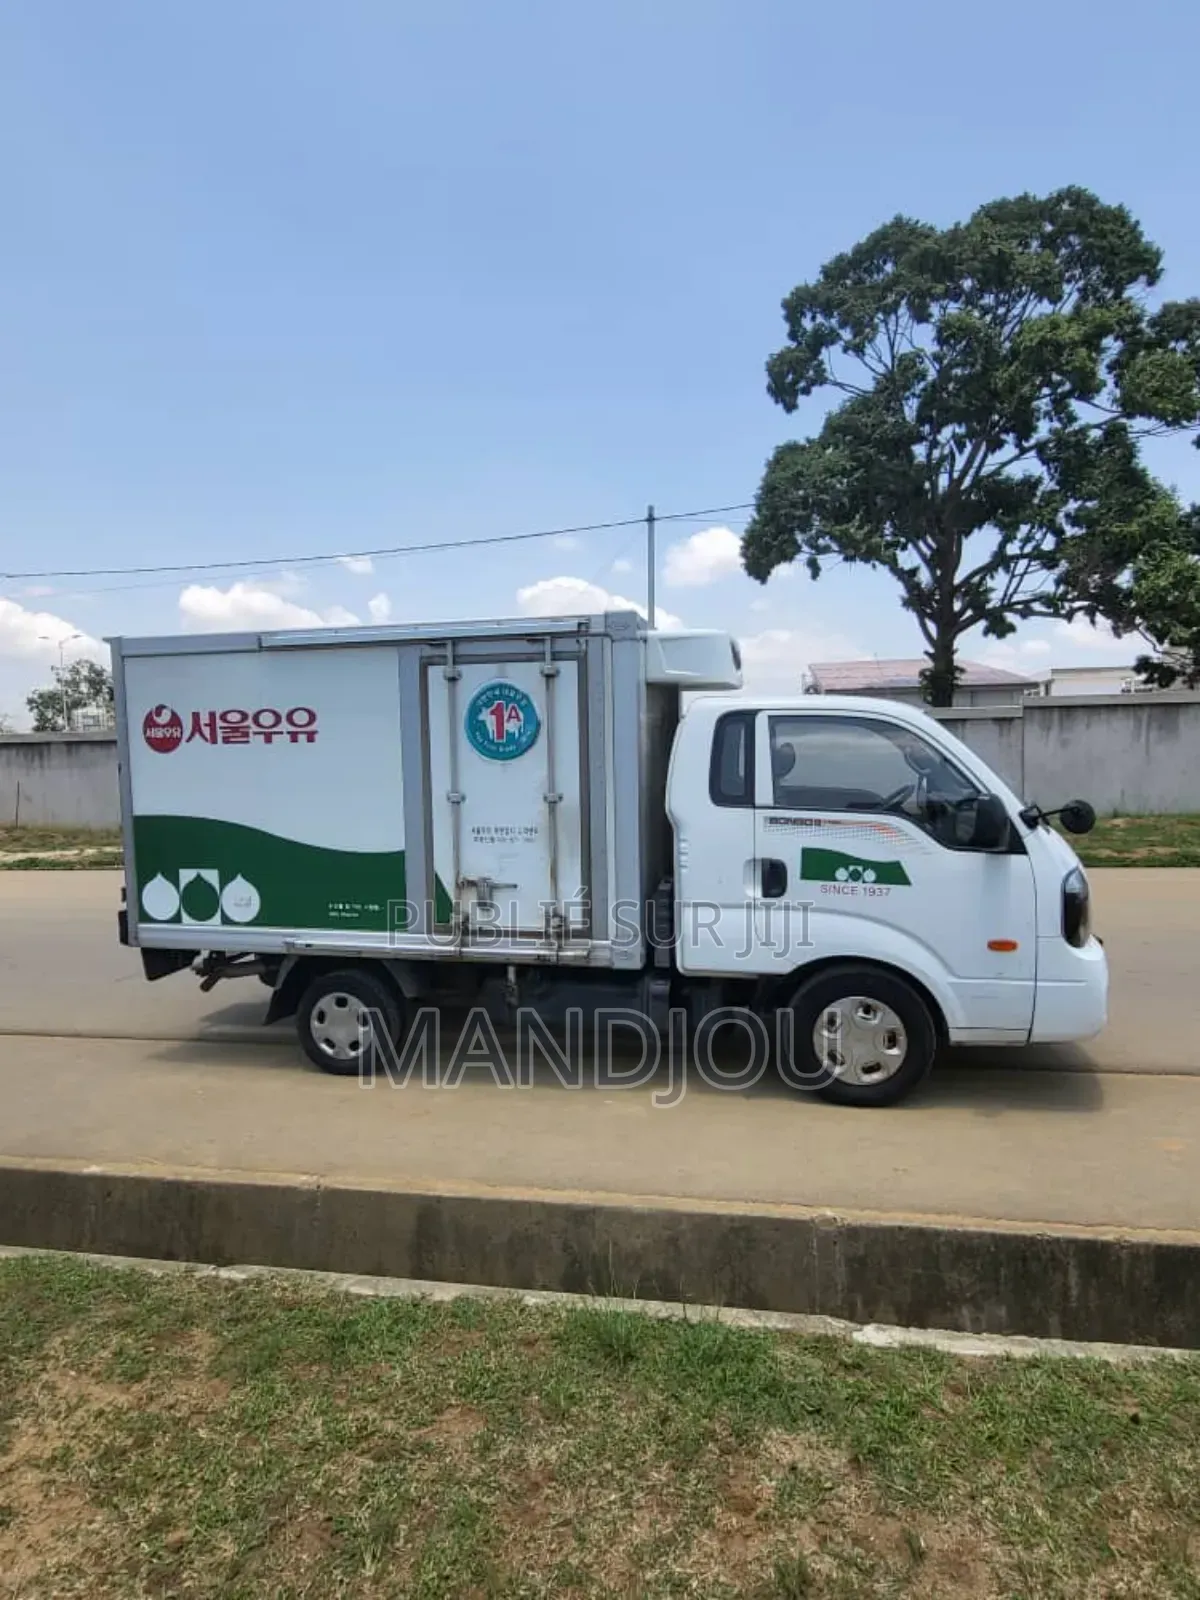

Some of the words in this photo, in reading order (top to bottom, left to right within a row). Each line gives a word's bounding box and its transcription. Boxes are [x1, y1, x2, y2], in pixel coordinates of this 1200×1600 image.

[185, 706, 319, 745] 서울우유
[146, 726, 182, 739] 서울우유
[820, 884, 859, 896] SINCE
[863, 886, 892, 897] 1937
